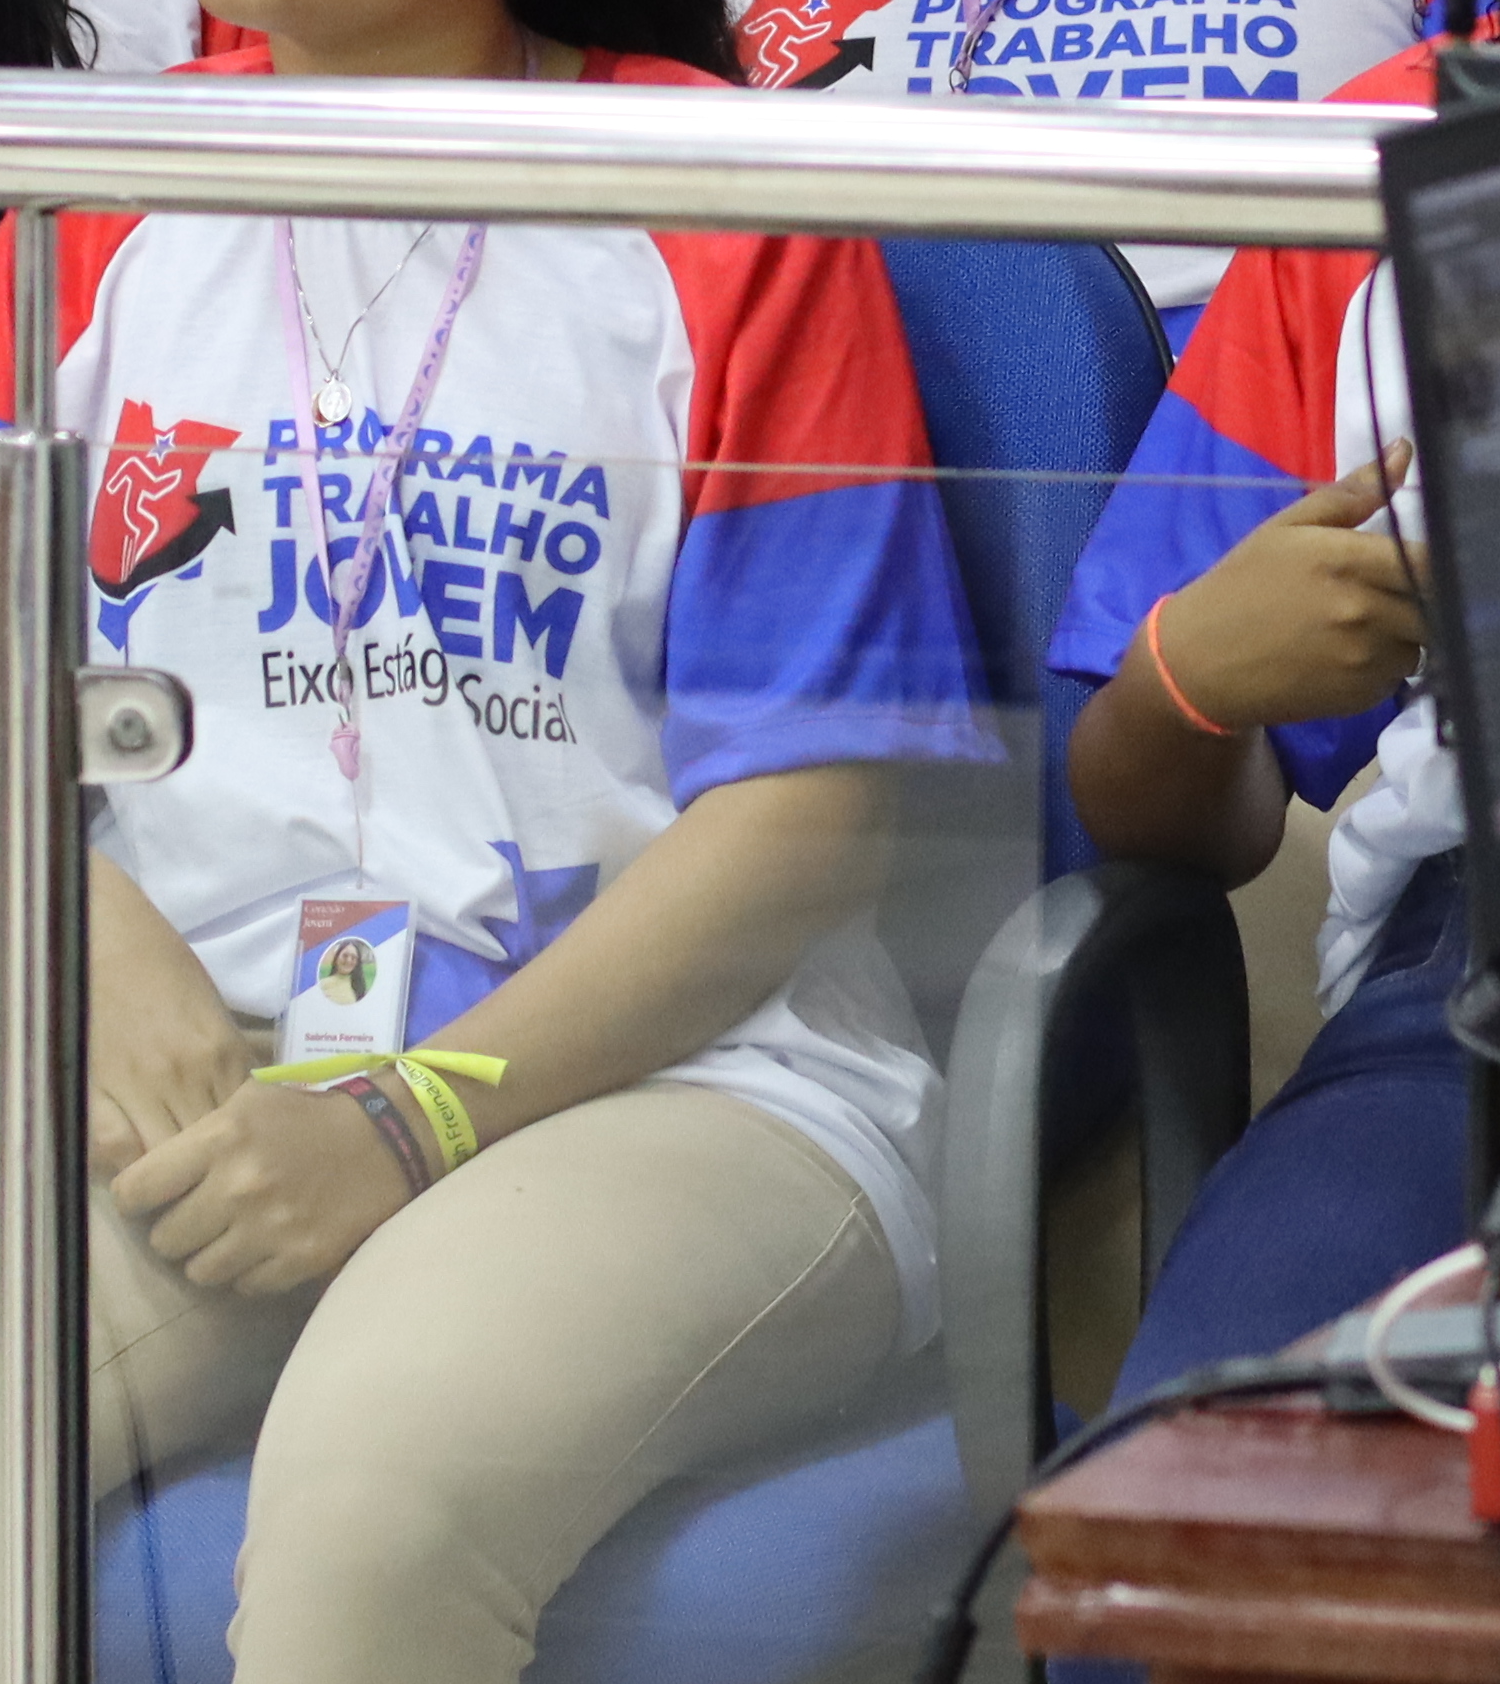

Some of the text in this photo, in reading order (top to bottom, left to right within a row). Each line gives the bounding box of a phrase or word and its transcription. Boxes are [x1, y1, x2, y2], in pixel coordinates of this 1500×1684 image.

[907, 13, 1298, 68] TRABALHO
[264, 406, 610, 520] PRORAMA
[263, 473, 601, 575] TRALHO
[258, 529, 585, 680] JOVEM
[262, 633, 577, 744] Eixo Estág Social
